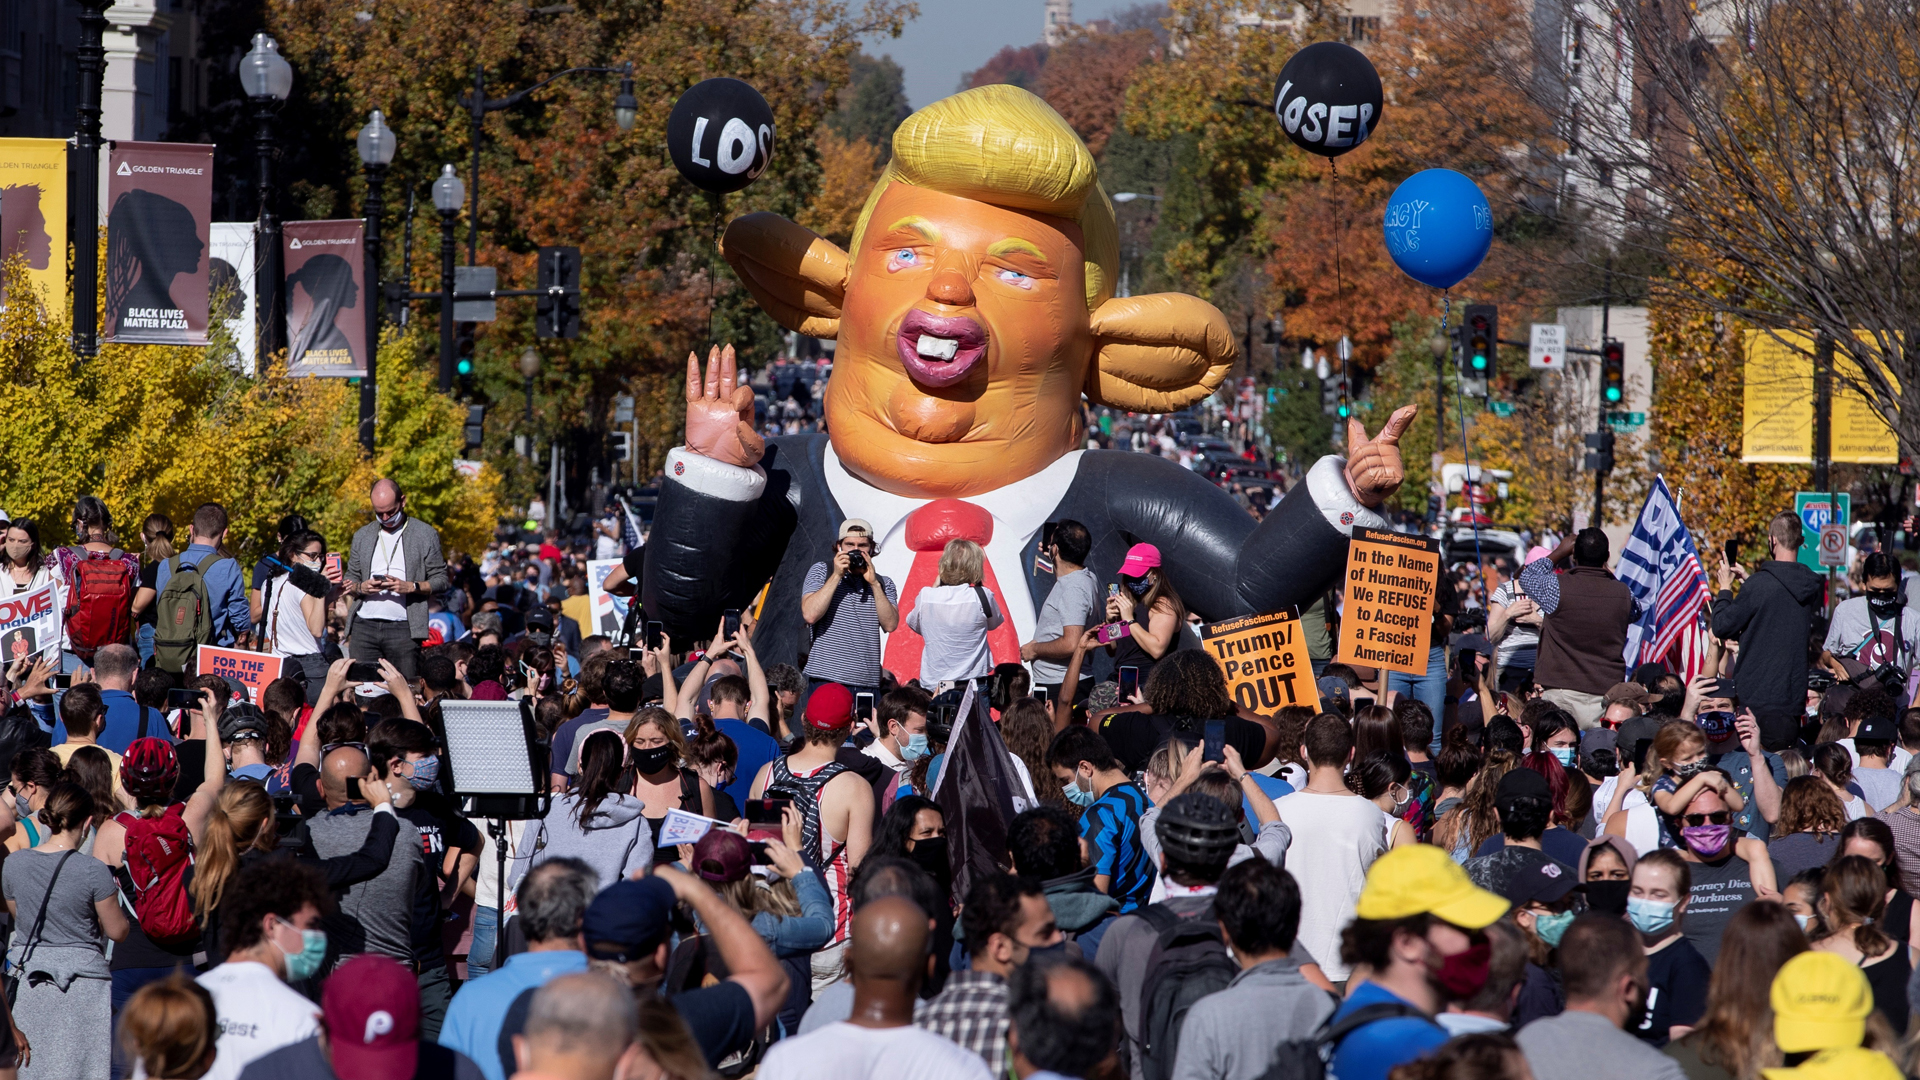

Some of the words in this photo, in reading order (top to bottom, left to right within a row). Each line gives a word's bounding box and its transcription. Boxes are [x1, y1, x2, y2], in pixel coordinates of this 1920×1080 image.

[1275, 80, 1373, 147] LOSER
[691, 117, 776, 179] LOS
[132, 165, 164, 174] GOLDEN
[165, 167, 203, 175] TRIANGLE
[128, 307, 158, 318] BLACK
[160, 308, 184, 319] LIVES
[123, 317, 159, 328] MATTER
[160, 318, 189, 330] PLAZA
[1540, 327, 1557, 337] NO
[1538, 336, 1559, 345] TURN
[305, 349, 328, 358] BLACK
[328, 348, 348, 357] LIVES
[329, 355, 352, 365] PLAZA
[1365, 530, 1427, 549] RefuseFascism.org
[1353, 547, 1367, 563] In
[1371, 550, 1394, 567] the
[1398, 553, 1434, 573] Name
[1350, 567, 1365, 581] of
[1368, 568, 1433, 596] Humanity,
[1353, 586, 1374, 602] We
[1377, 589, 1428, 611] REFUSE
[1211, 611, 1289, 635] RefuseFascism.org
[1357, 606, 1371, 621] to
[1374, 608, 1420, 630] Accept
[1213, 623, 1293, 659] Trump/
[1355, 628, 1365, 640] a
[1368, 627, 1417, 648] Fascist
[213, 656, 237, 669] FOR
[240, 660, 265, 673] THE
[1353, 644, 1414, 667] America!
[213, 667, 261, 685] PEOPLE,
[1225, 652, 1295, 681] Pence
[1235, 672, 1297, 712] OUT
[1701, 717, 1731, 730] BIDEN
[1727, 879, 1752, 889] Dies
[1689, 893, 1743, 905] Darkness
[363, 1010, 395, 1045] P
